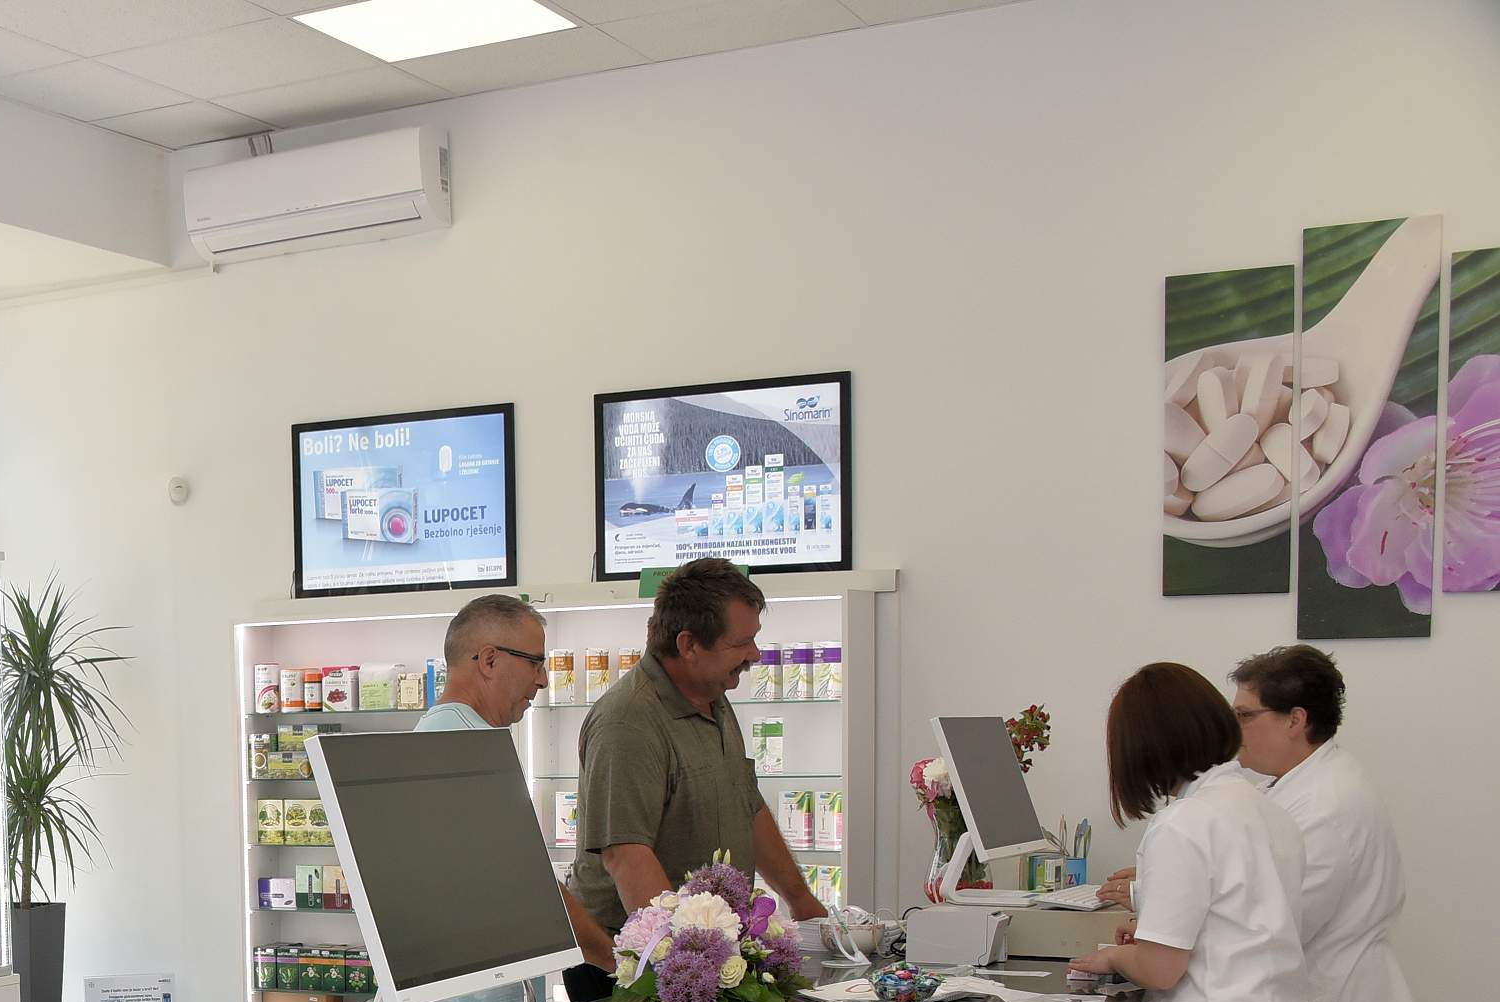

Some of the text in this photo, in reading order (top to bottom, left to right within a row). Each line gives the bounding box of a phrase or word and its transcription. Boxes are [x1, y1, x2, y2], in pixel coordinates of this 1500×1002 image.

[784, 408, 831, 422] Sinomarin
[618, 424, 640, 436] VODA
[303, 428, 411, 456] Boli? Ne boli!
[326, 478, 354, 487] LUPOCET
[349, 499, 378, 508] LUPOCET
[424, 505, 488, 524] LUPOCET
[424, 524, 503, 539] Bezbolno rješenje
[676, 537, 797, 551] 100% PRIRODAN NAZALNI DEKONGESTIV
[751, 547, 778, 555] MORSKE
